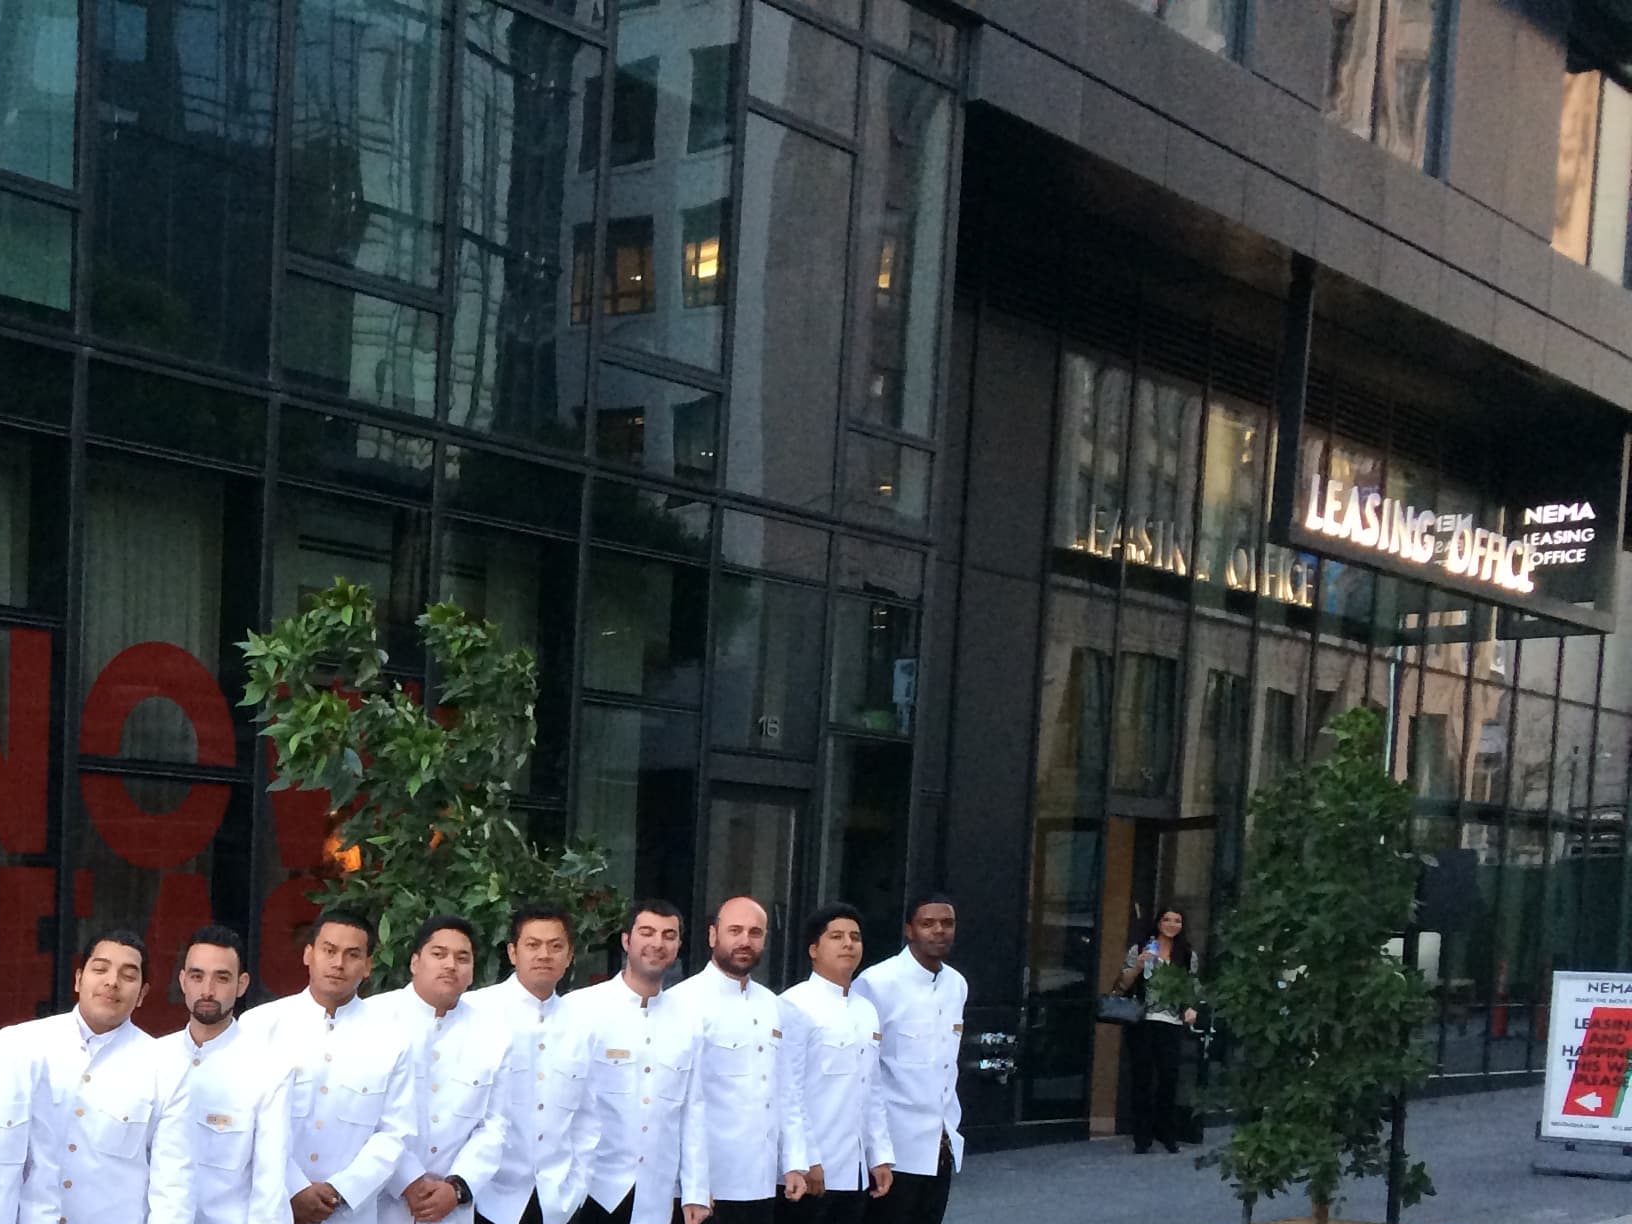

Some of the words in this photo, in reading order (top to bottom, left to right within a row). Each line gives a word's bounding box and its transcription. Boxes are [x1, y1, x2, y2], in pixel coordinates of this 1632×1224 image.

[1524, 501, 1596, 525] NEMA
[1305, 473, 1435, 564] LEASING
[1446, 526, 1536, 593] OFFICE
[1523, 528, 1595, 548] LEASING
[1529, 548, 1587, 566] OFFICE
[1588, 982, 1632, 994] NEMA
